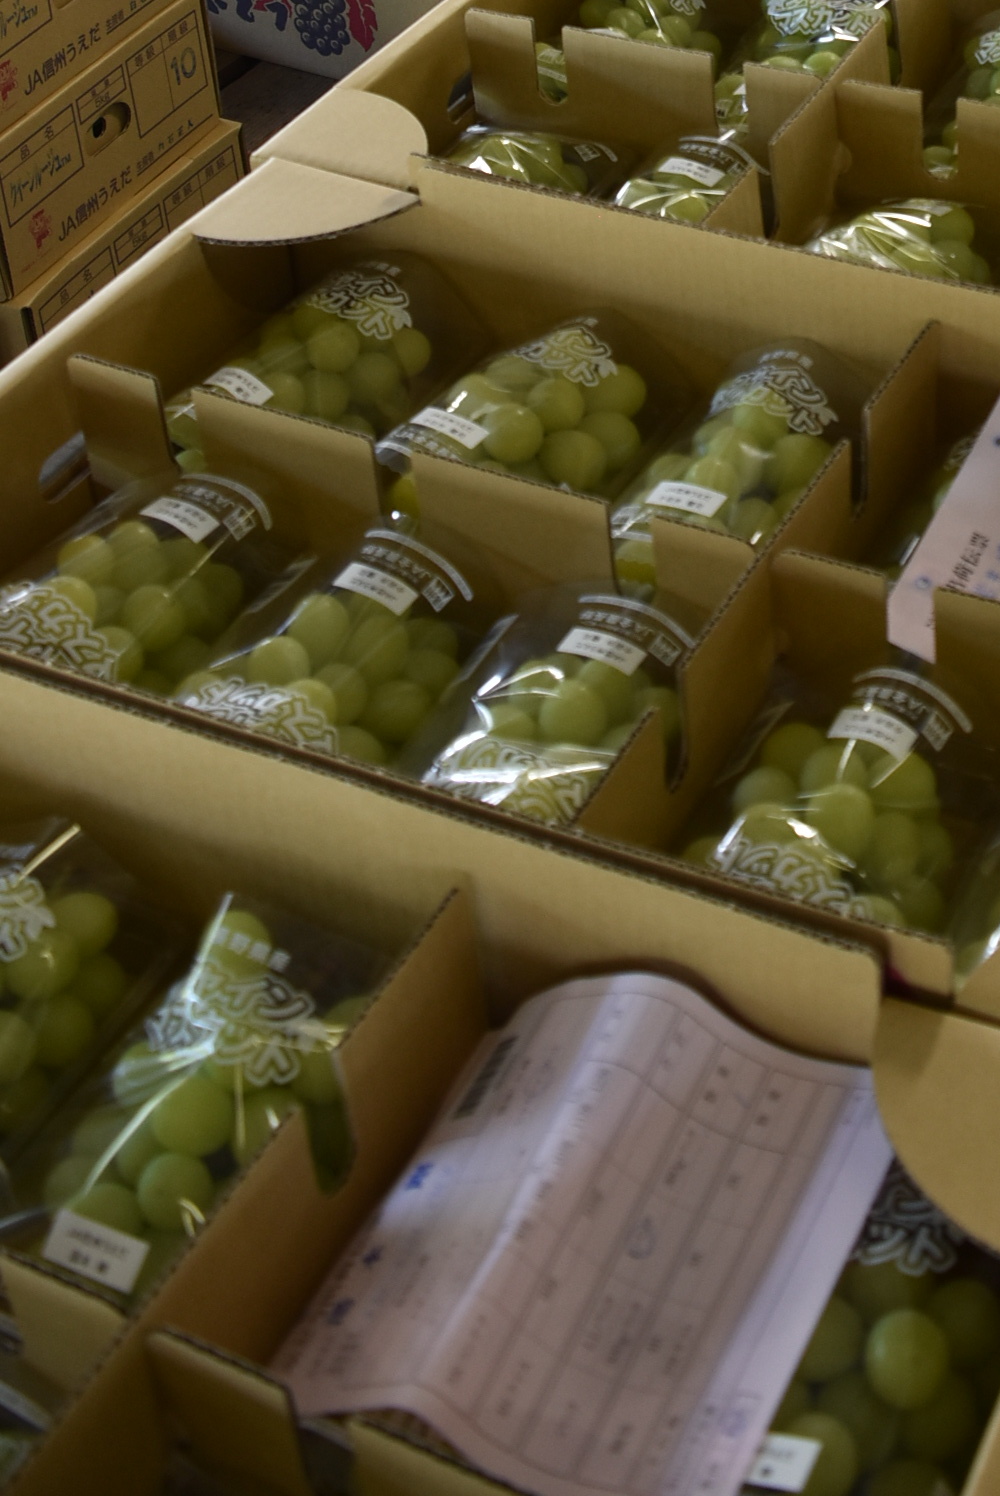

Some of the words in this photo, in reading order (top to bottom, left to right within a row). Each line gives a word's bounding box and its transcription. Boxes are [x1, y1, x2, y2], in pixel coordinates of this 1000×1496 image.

[24, 23, 102, 96] JA信州うえだ
[168, 46, 197, 86] 10
[57, 165, 133, 243] JA信州うえだ
